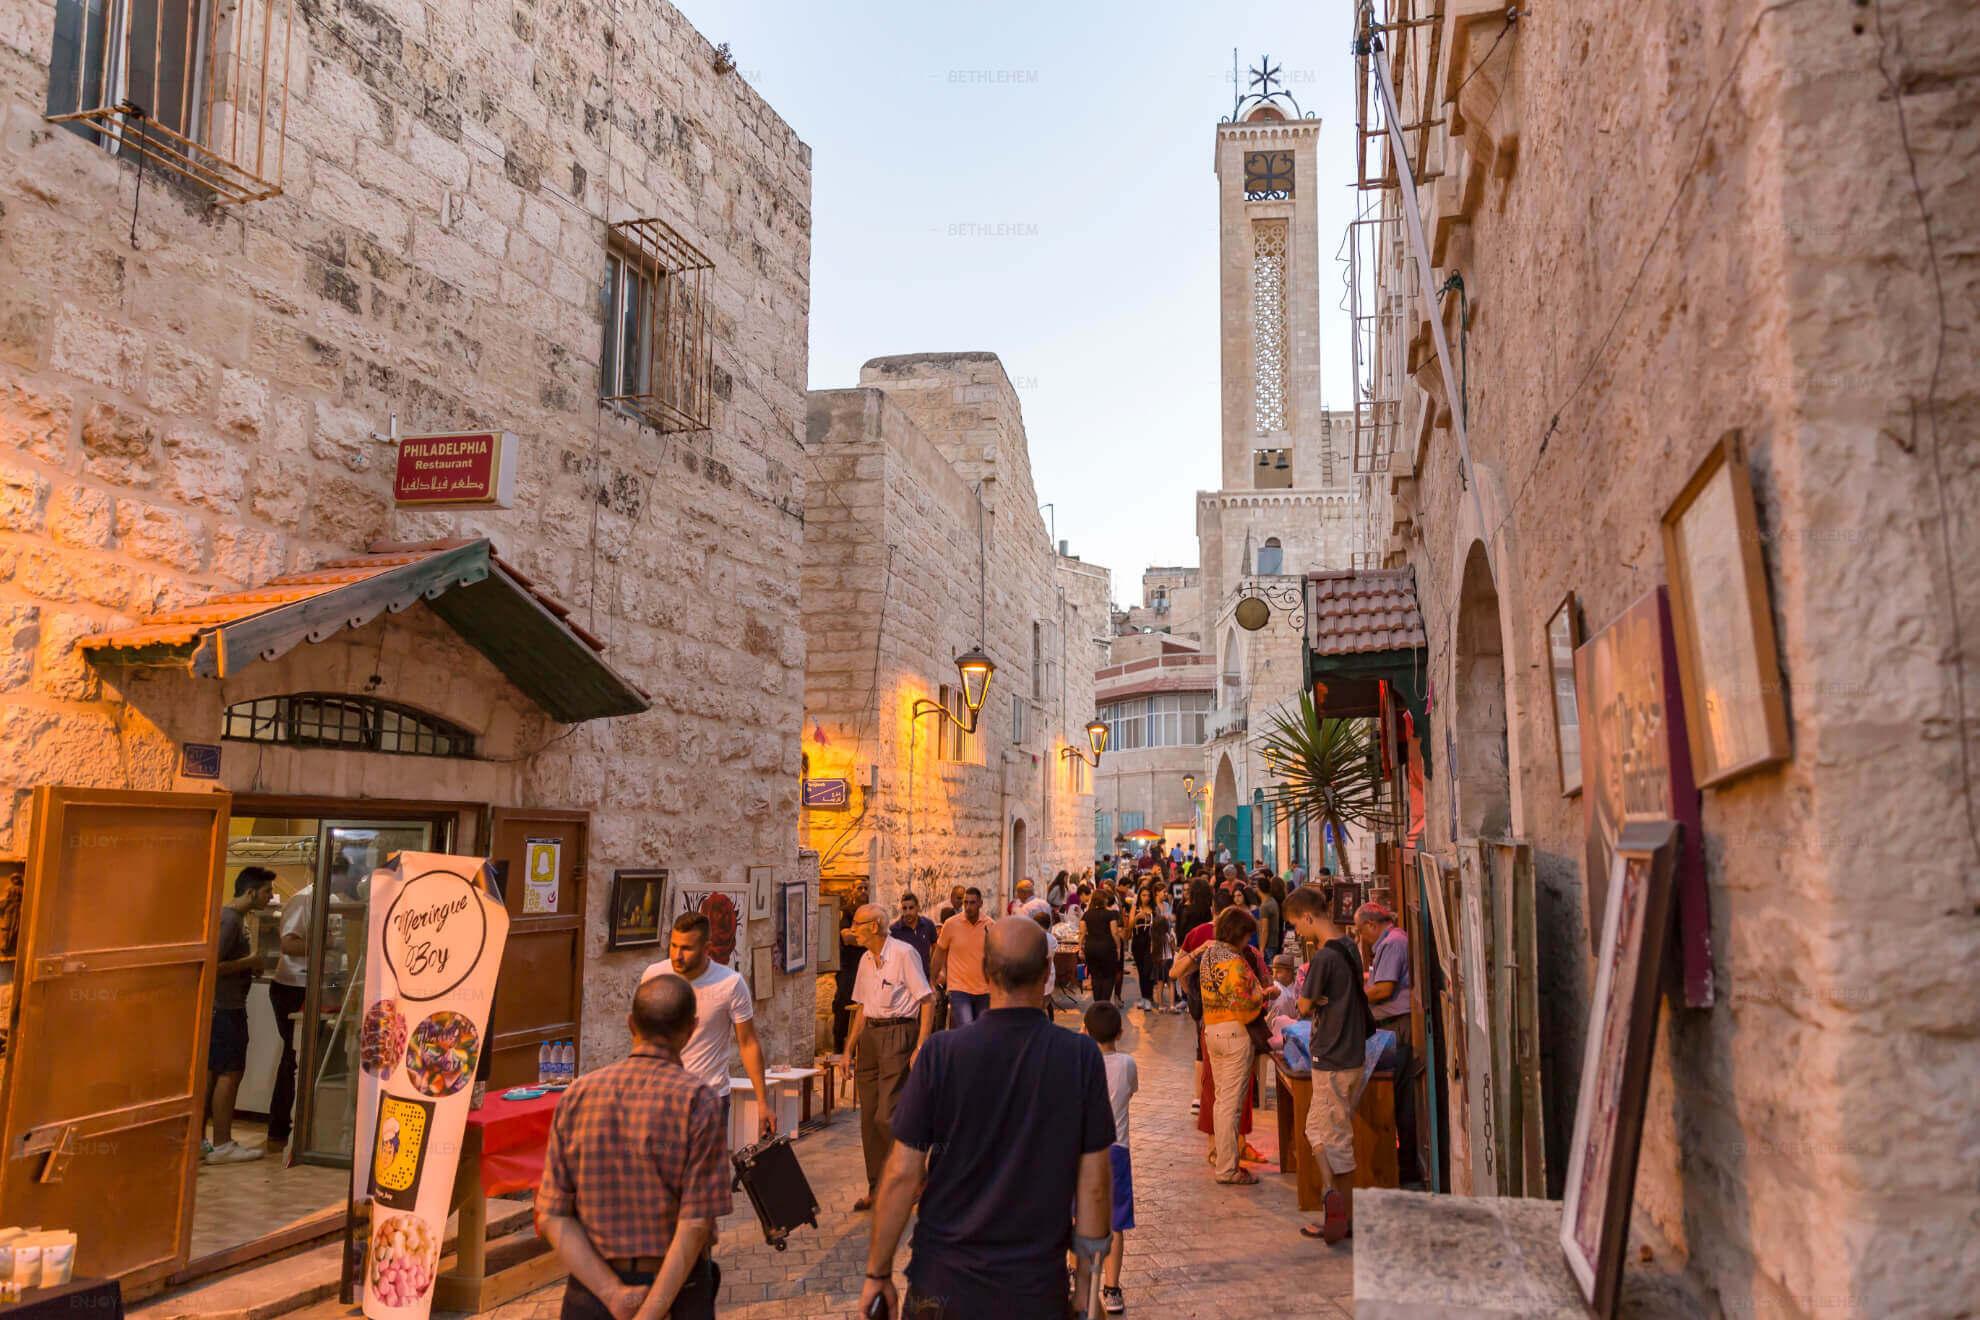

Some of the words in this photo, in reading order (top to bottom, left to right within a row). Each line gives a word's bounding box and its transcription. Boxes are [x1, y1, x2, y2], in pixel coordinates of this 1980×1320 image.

[404, 441, 487, 457] PHILADELPHIA
[415, 459, 473, 470] Restaurant
[393, 894, 468, 945] Meringue
[404, 941, 449, 976] Boy
